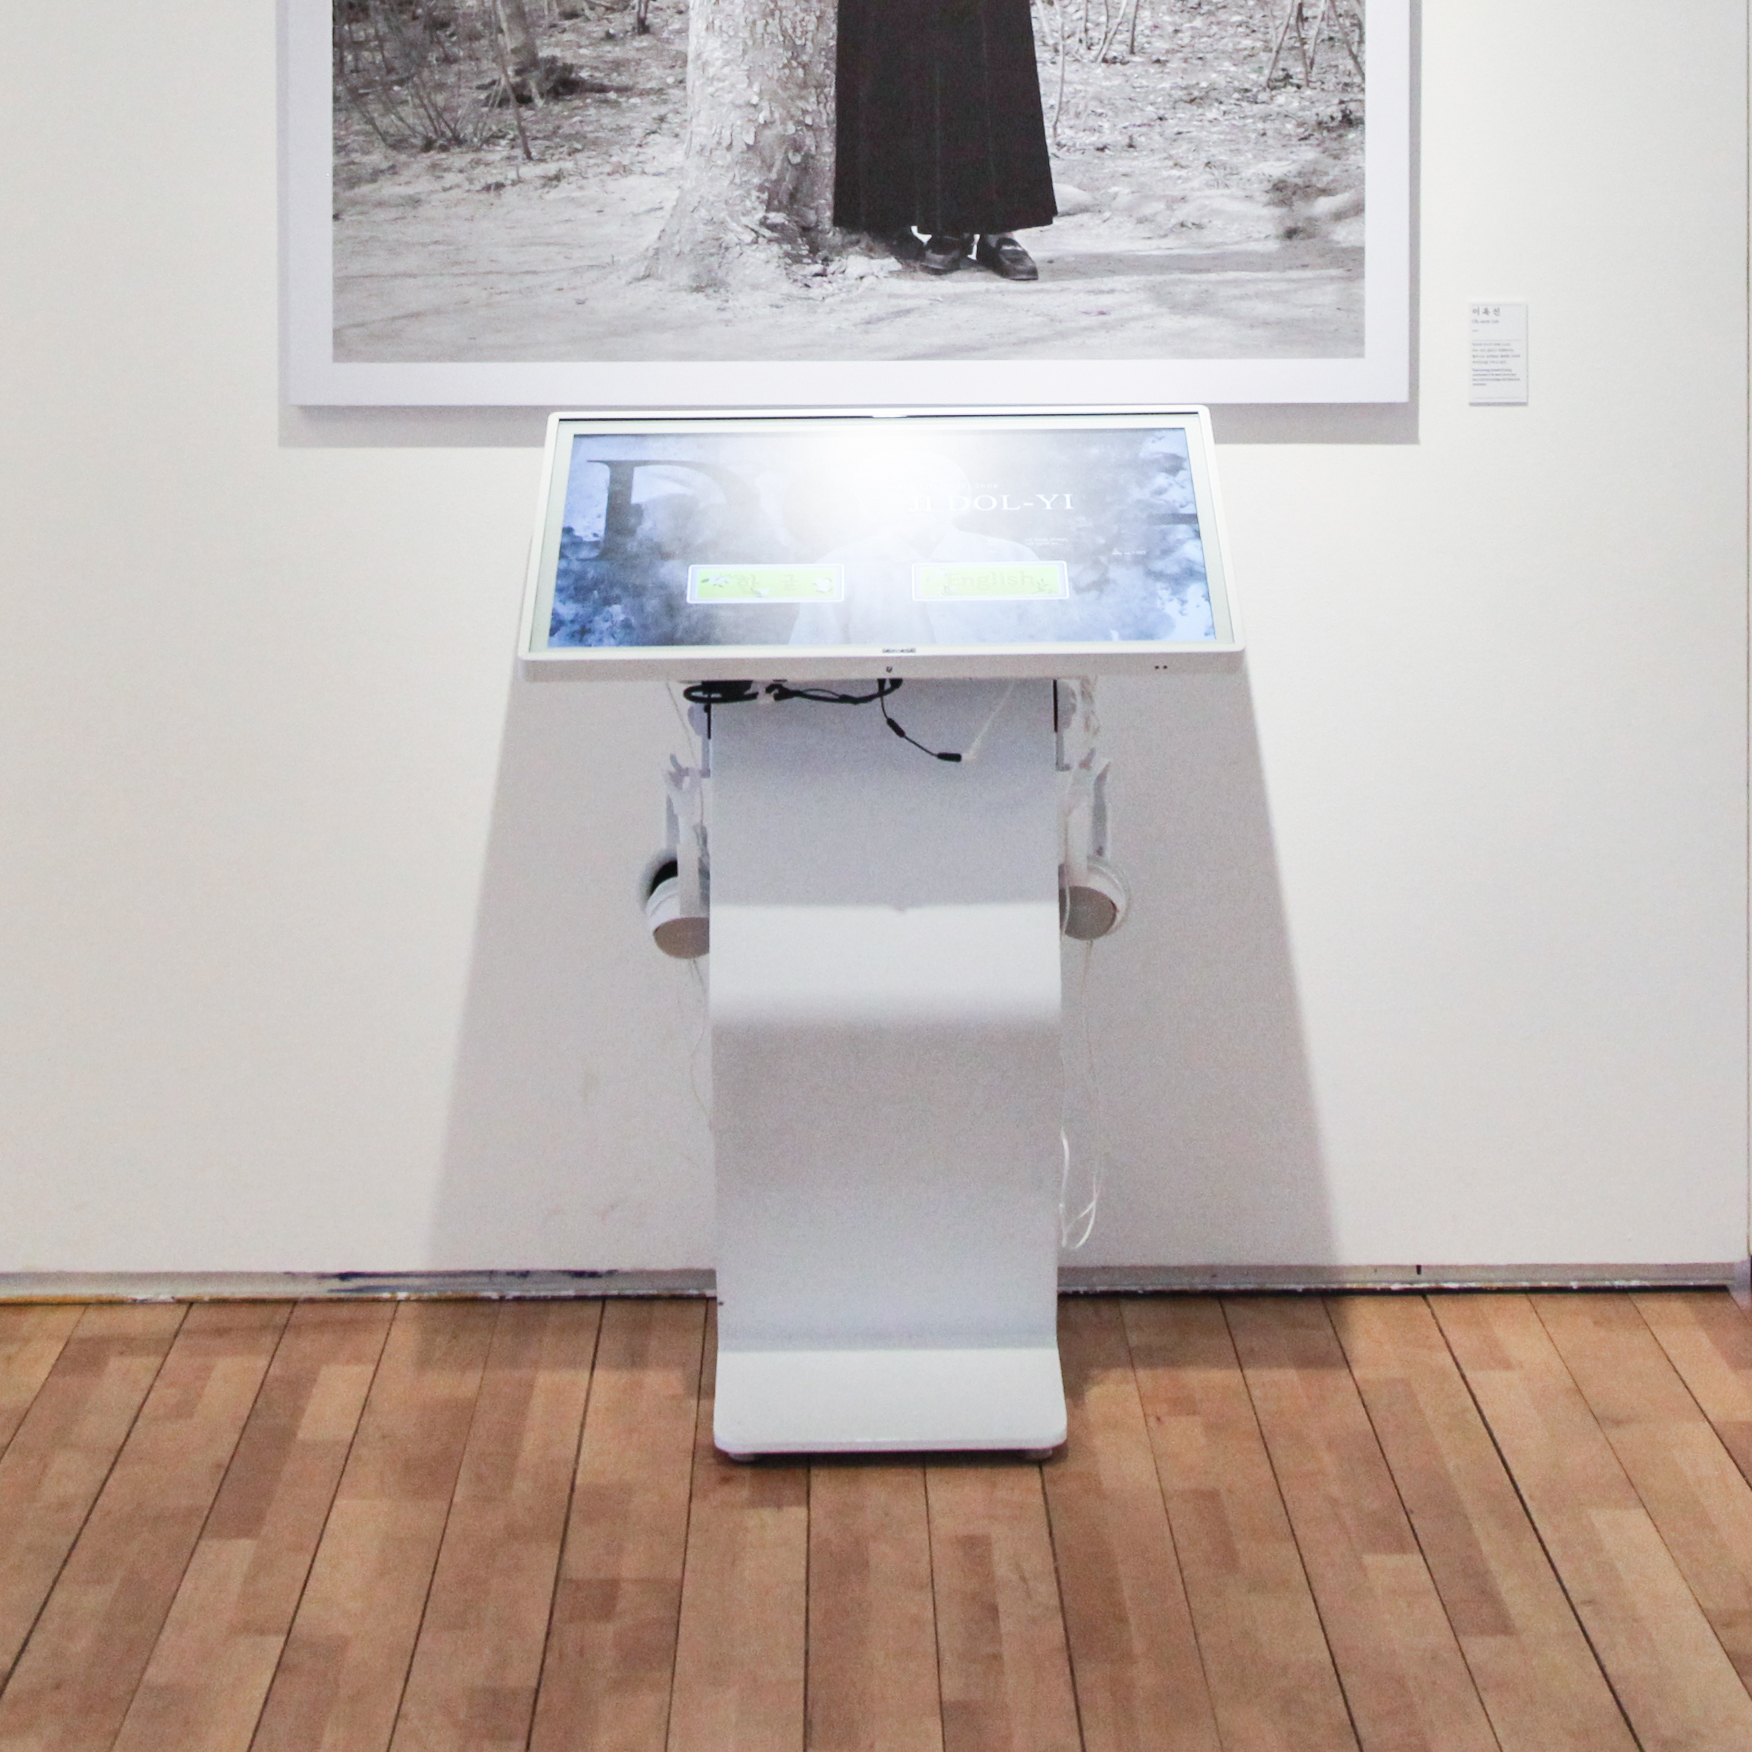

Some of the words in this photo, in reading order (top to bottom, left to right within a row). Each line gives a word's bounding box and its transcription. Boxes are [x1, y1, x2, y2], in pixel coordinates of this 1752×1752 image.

[908, 495, 935, 513] JI
[947, 493, 1075, 513] DOL-YI
[946, 569, 1037, 592] English
